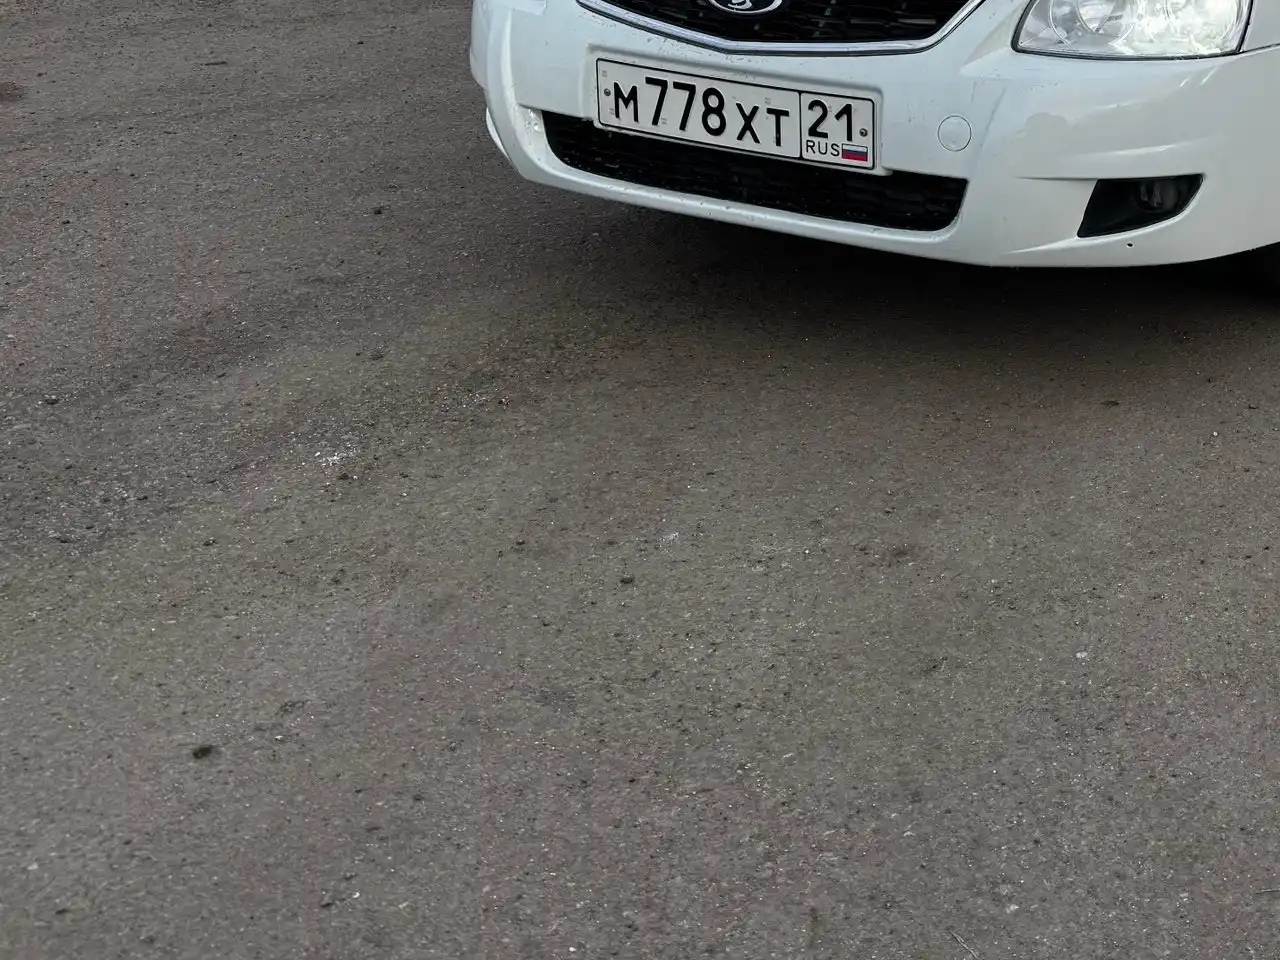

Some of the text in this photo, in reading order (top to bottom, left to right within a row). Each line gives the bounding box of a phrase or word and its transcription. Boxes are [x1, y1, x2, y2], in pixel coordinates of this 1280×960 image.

[613, 76, 853, 147] М778ХТ 21
[806, 139, 840, 157] RUS
